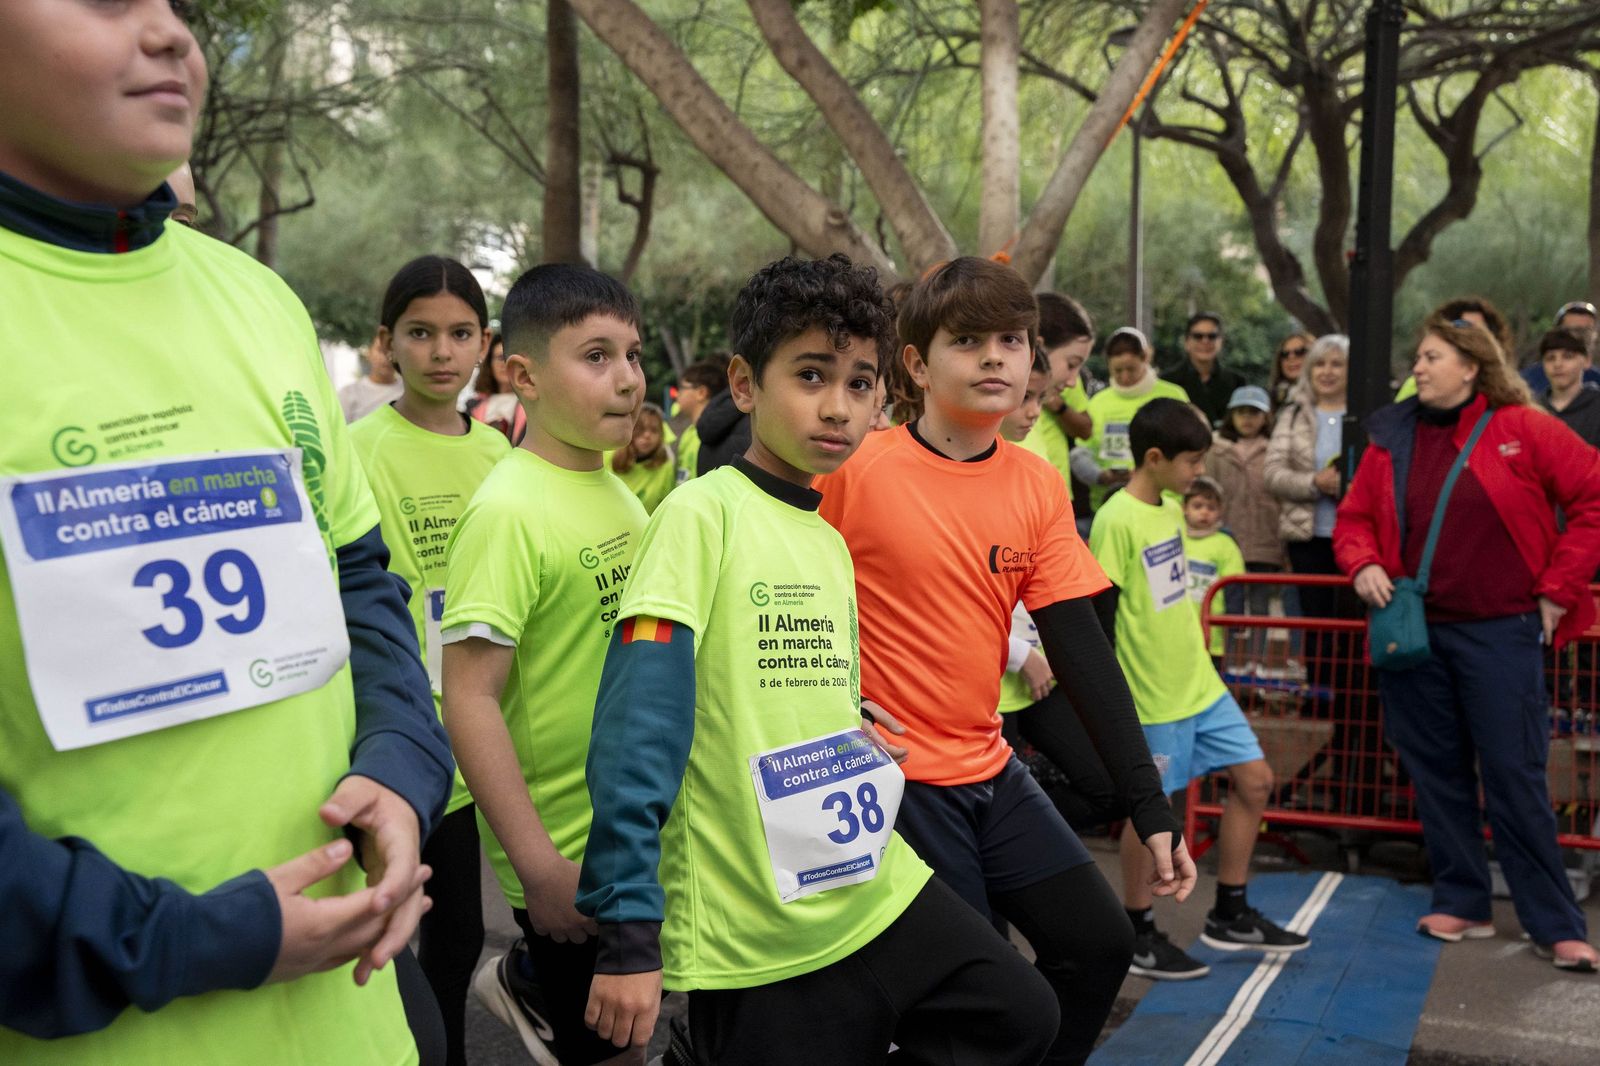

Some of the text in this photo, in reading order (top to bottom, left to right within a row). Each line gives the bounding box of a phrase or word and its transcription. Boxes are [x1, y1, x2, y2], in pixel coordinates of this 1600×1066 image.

[34, 466, 277, 515] II Almería en marcha
[56, 511, 150, 544] contra
[154, 504, 180, 528] el
[182, 498, 257, 525] cáncer
[409, 515, 460, 533] II Alme
[413, 532, 450, 545] en ma
[416, 545, 445, 558] contr
[595, 572, 609, 591] II
[132, 548, 266, 649] 39
[600, 591, 619, 606] en
[601, 607, 620, 622] co
[758, 613, 834, 633] II Almería
[758, 635, 833, 650] en marcha
[758, 654, 808, 669] contra
[811, 653, 824, 668] el
[760, 678, 766, 688] 8
[769, 678, 782, 687] de
[785, 677, 818, 687] febrero
[820, 677, 830, 687] de
[771, 759, 782, 773] II
[783, 745, 836, 770] Almería
[837, 742, 850, 754] en
[783, 766, 830, 788] contra
[832, 761, 844, 774] el
[845, 752, 874, 770] cáncer
[821, 782, 884, 844] 38
[803, 859, 871, 881] #TodosContraElCáncer
